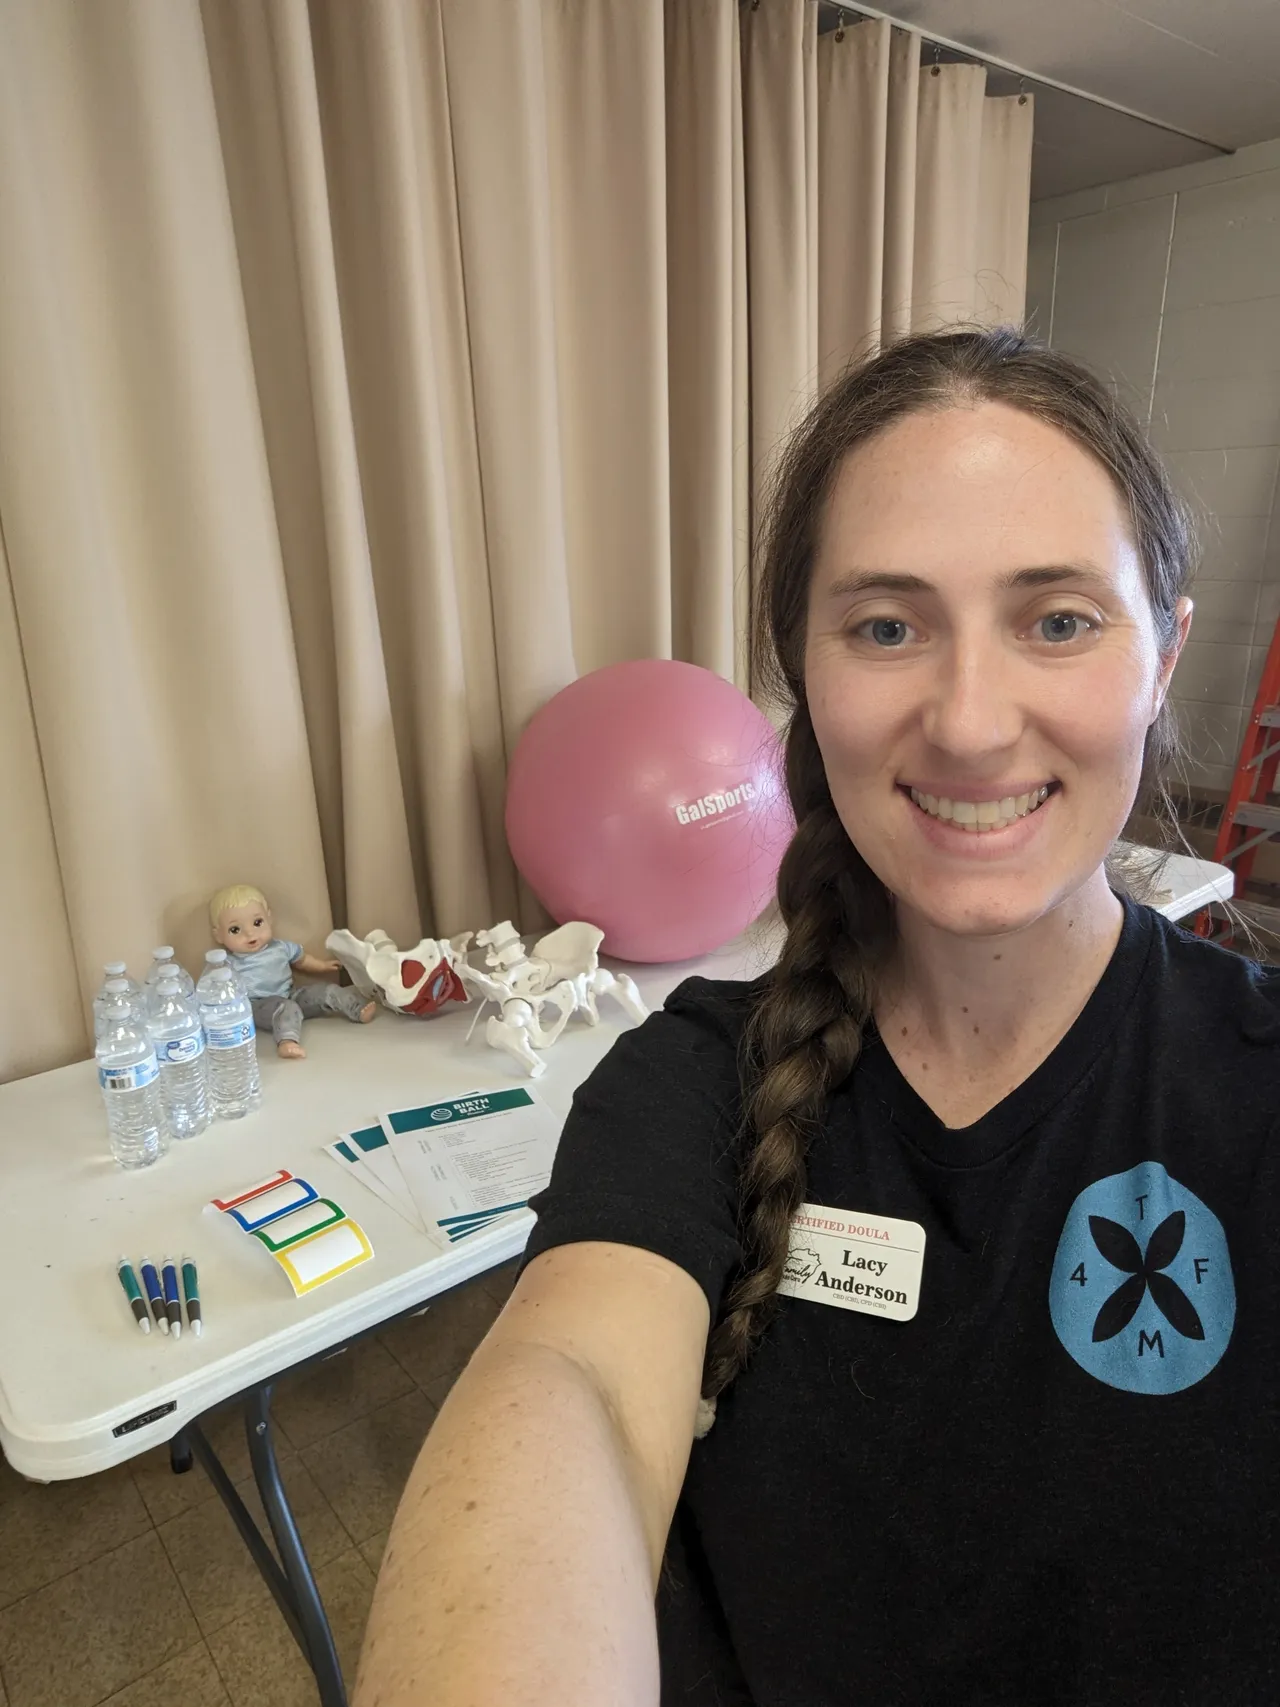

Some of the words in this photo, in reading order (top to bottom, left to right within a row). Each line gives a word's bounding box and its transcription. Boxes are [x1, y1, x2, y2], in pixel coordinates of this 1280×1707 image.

[675, 783, 756, 825] GalSports
[452, 1097, 490, 1110] BIRTH
[459, 1104, 490, 1114] BALL
[1135, 1194, 1148, 1220] T
[793, 1215, 845, 1232] RTIFIED
[847, 1224, 890, 1240] DOULA
[841, 1249, 888, 1276] Lacy
[1069, 1262, 1088, 1287] 4
[1193, 1258, 1209, 1284] F
[814, 1270, 908, 1305] Anderson
[1137, 1330, 1165, 1358] M
